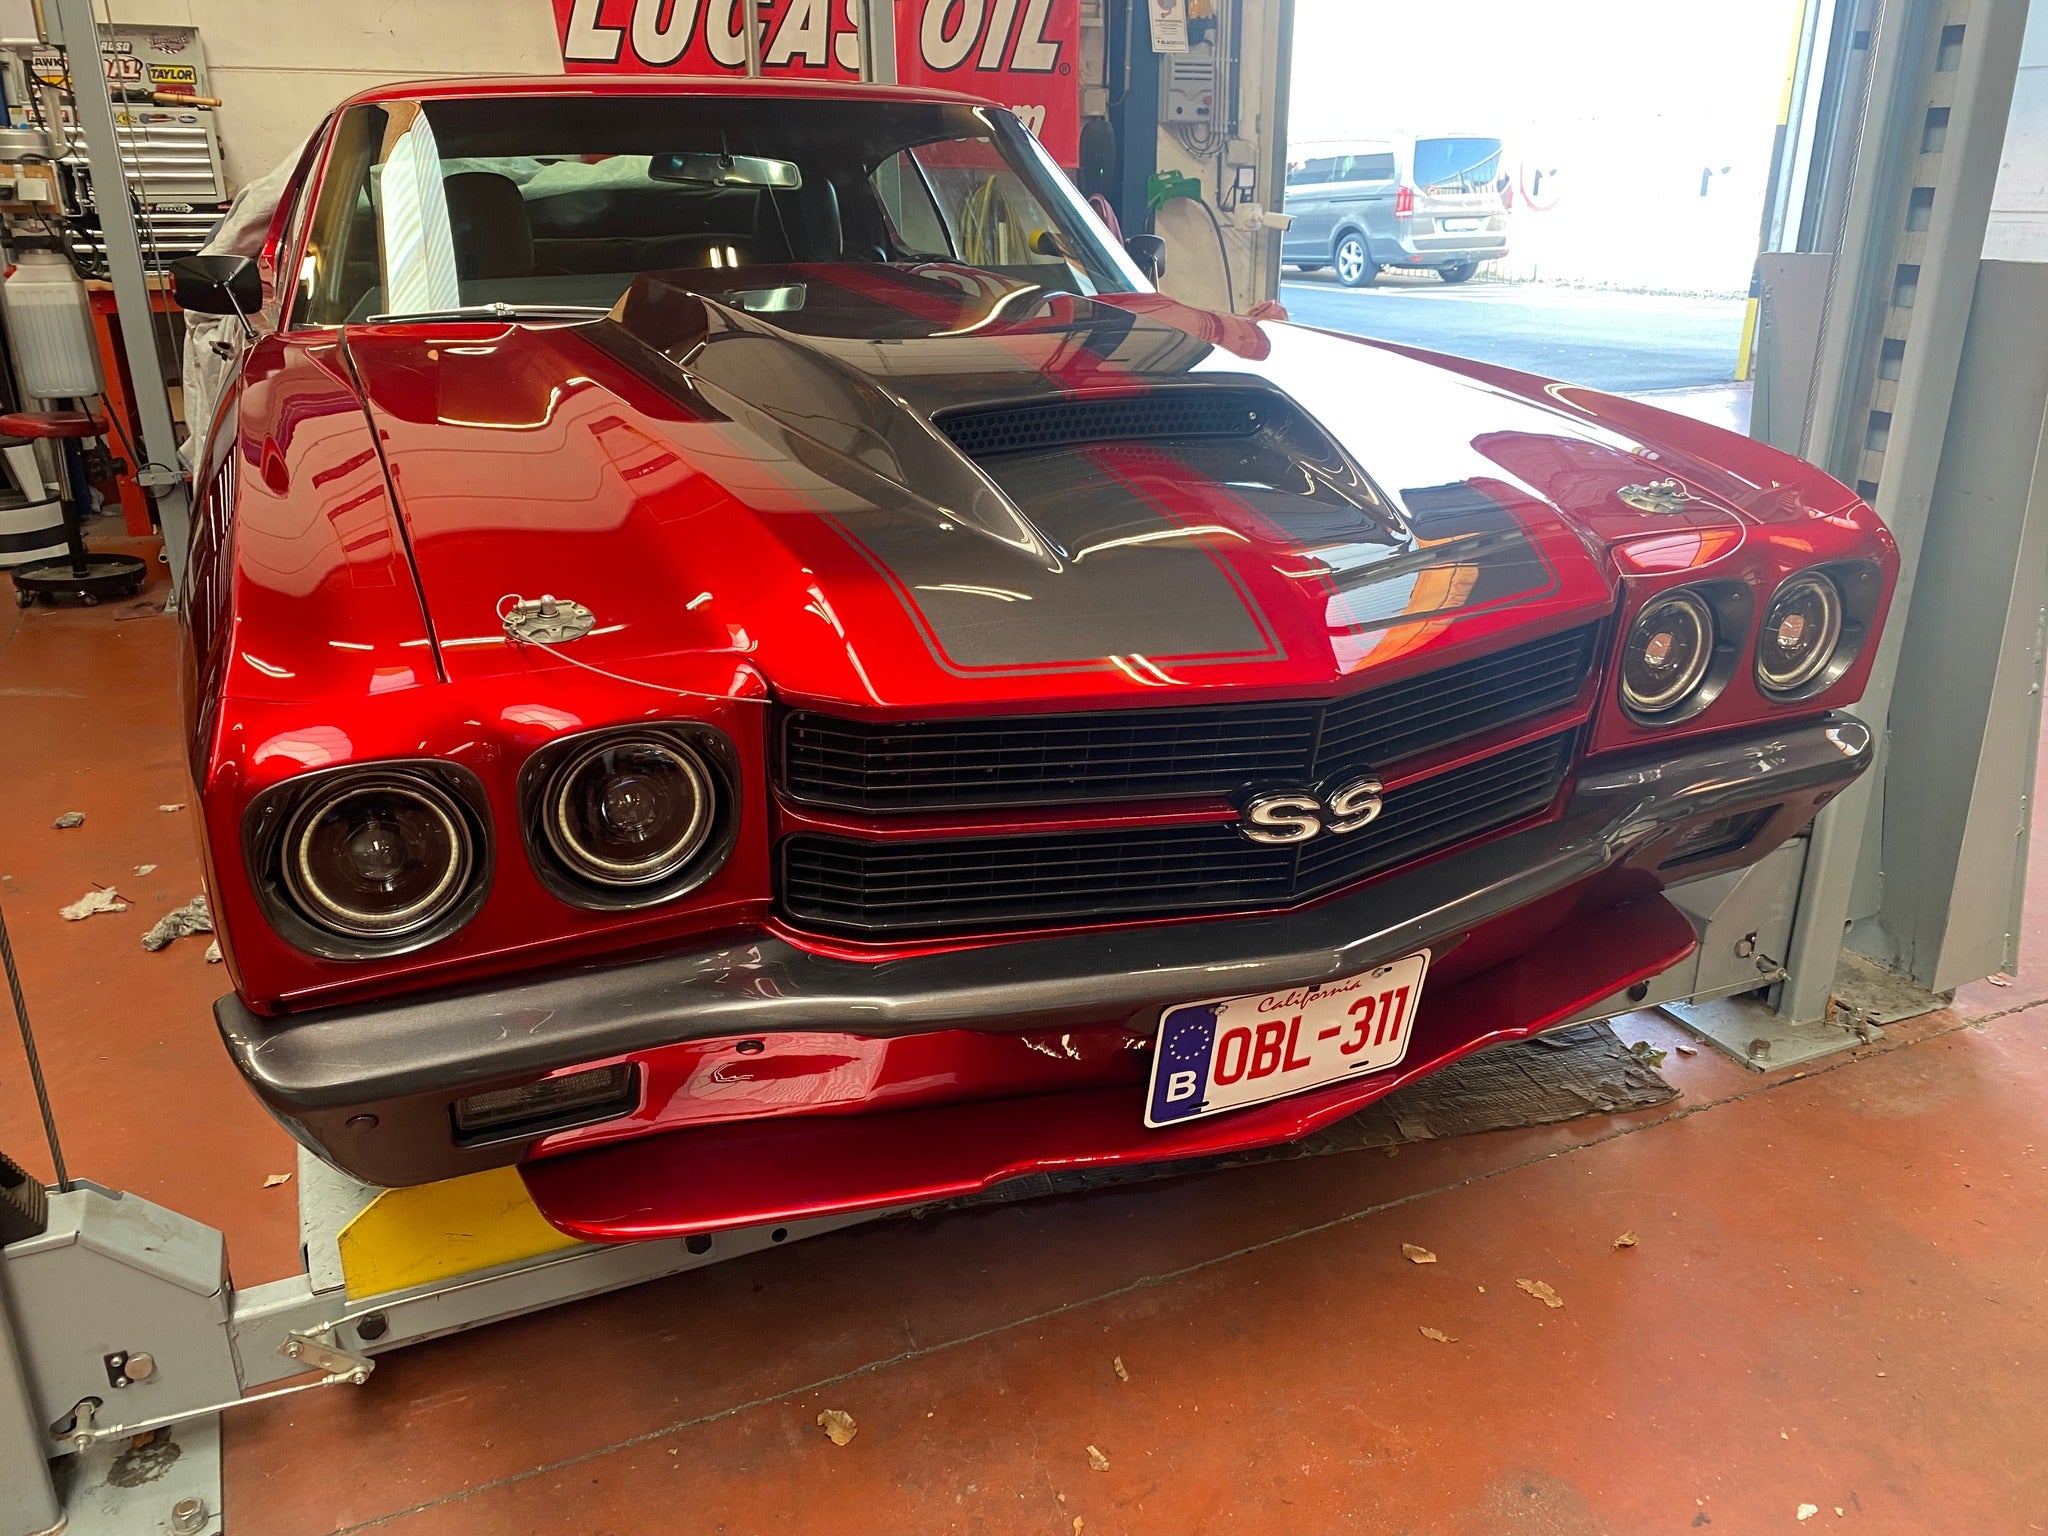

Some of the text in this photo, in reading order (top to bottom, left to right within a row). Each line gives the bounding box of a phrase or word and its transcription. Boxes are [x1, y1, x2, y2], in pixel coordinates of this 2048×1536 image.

[564, 0, 860, 76] LUCA
[35, 58, 63, 66] AWK
[150, 68, 193, 80] TAYLOR
[1243, 781, 1384, 845] SS
[1257, 979, 1362, 1014] California
[1166, 1070, 1198, 1103] B
